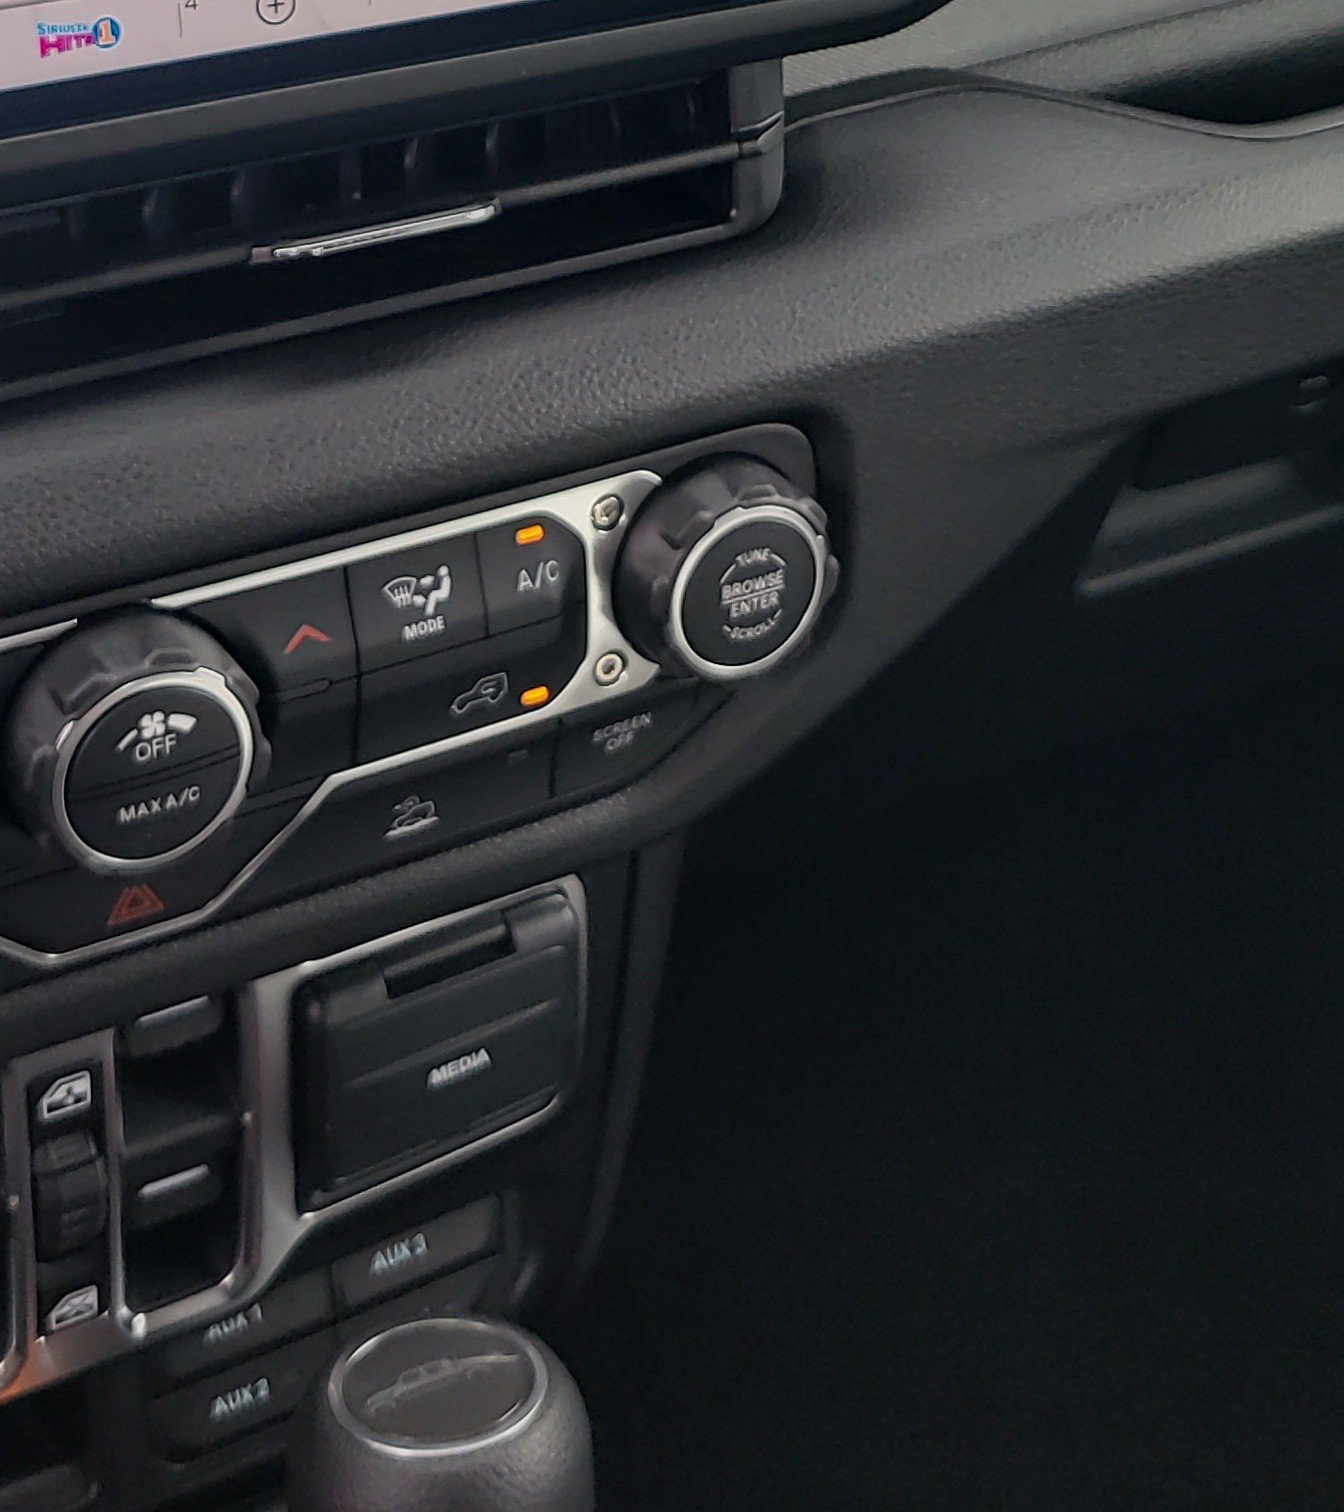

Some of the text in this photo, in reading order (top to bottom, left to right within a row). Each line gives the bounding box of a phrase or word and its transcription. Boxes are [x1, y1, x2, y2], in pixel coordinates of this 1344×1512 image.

[517, 559, 559, 592] A/C
[722, 569, 785, 600] BROWSE
[730, 591, 779, 618] ENTER
[402, 615, 446, 642] MODE
[136, 733, 177, 761] OFF
[119, 786, 201, 824] MAX A/C
[427, 1047, 492, 1088] MEDIA
[370, 1239, 412, 1275] AUX
[204, 1312, 248, 1342] AUX
[210, 1383, 255, 1420] AUX
